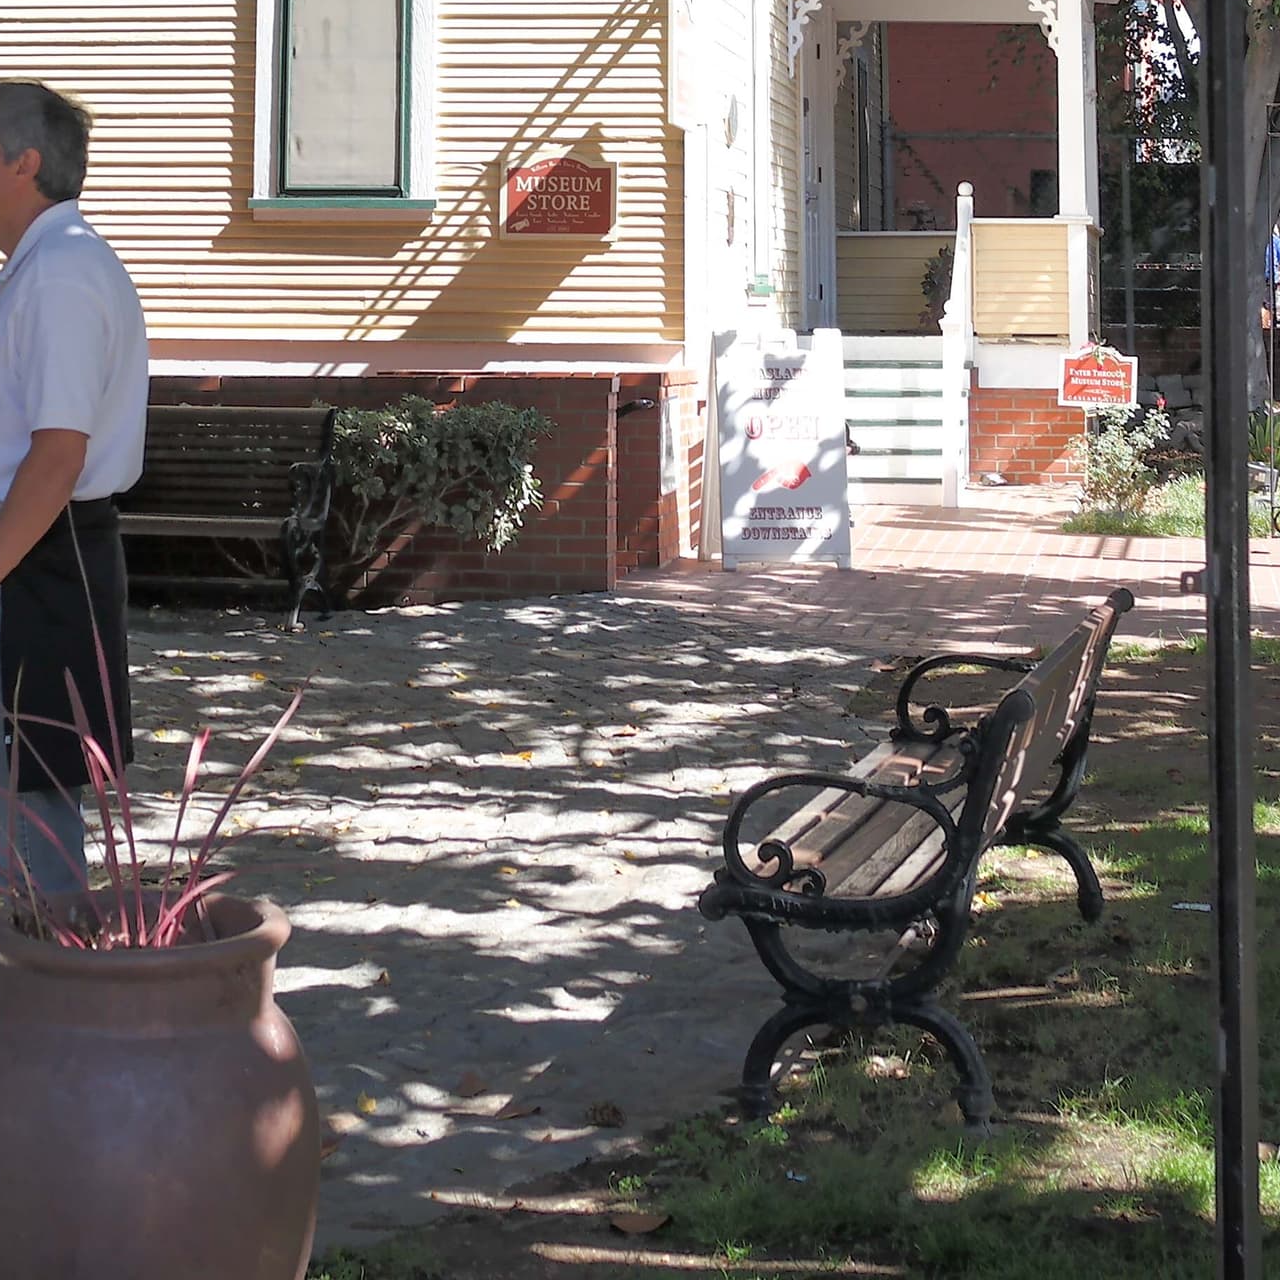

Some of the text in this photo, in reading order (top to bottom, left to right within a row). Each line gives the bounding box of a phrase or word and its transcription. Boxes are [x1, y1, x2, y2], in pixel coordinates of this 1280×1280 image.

[515, 176, 602, 192] MUSEUM
[527, 194, 590, 211] STORE
[1069, 368, 1091, 377] ENTER
[1070, 377, 1101, 386] MUSEUM
[749, 507, 823, 520] ENTRANCE
